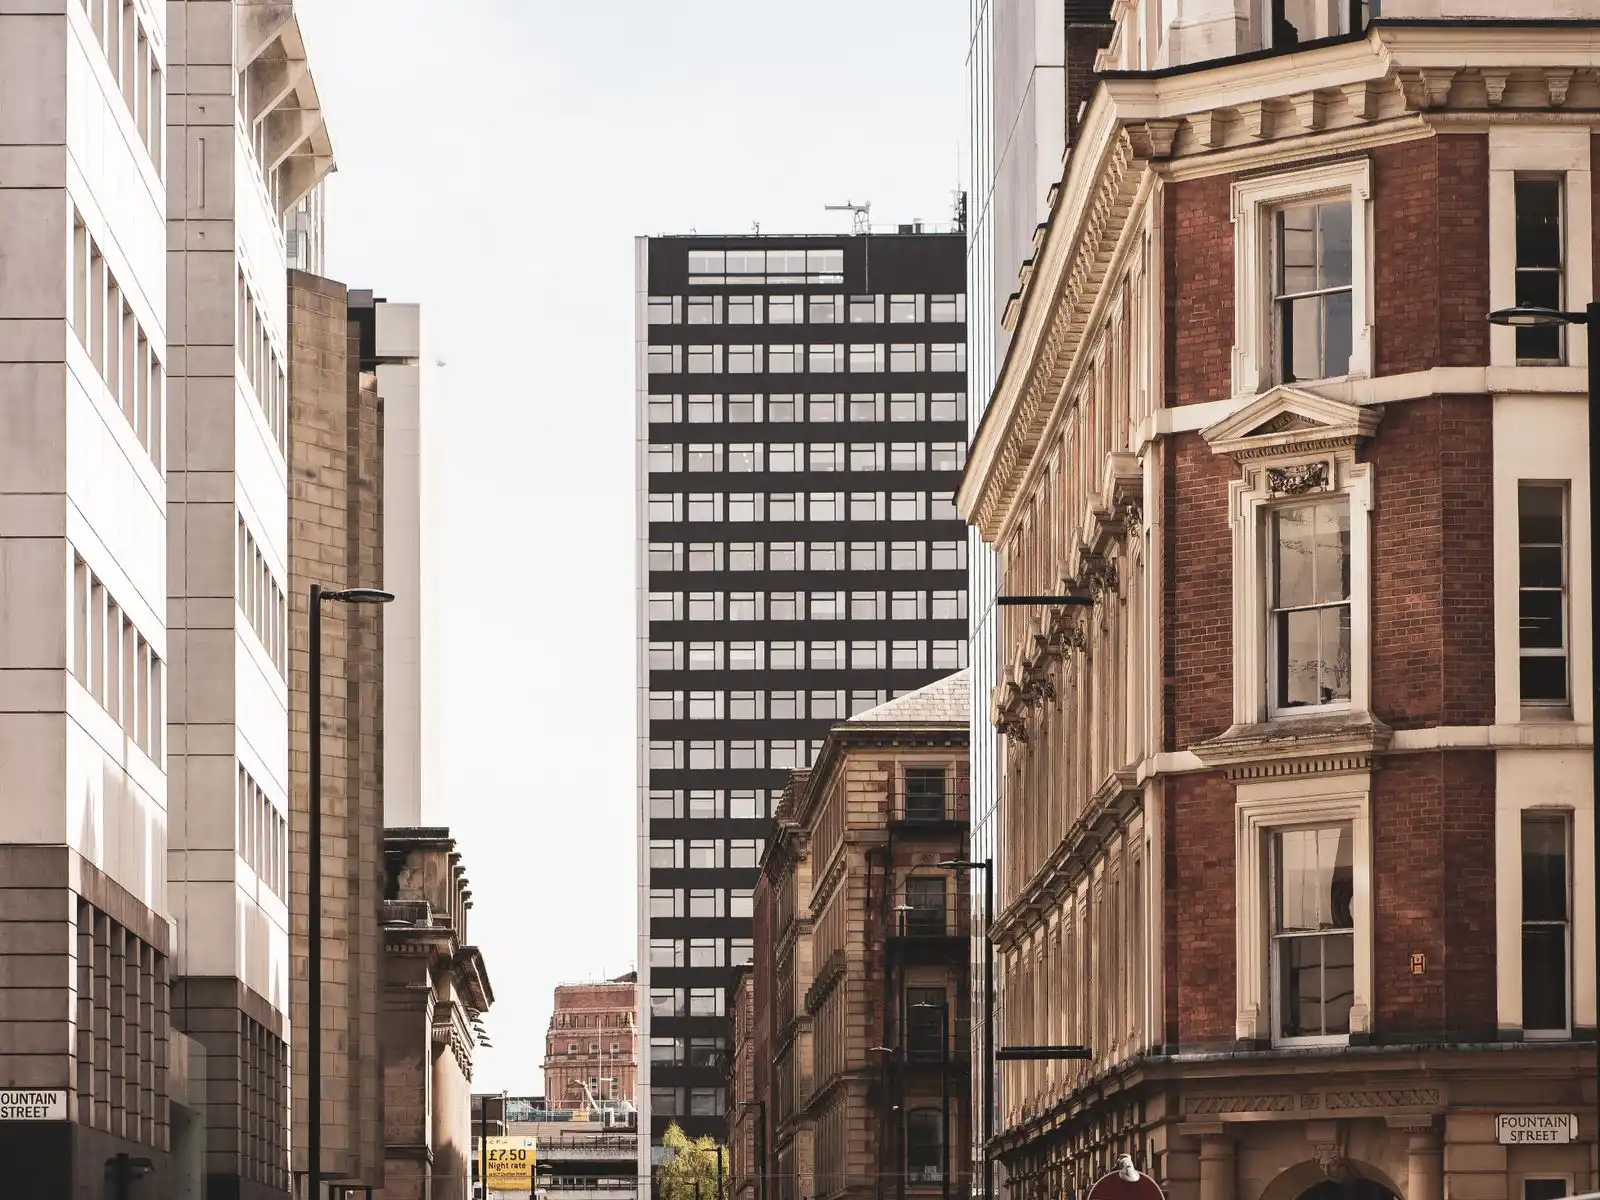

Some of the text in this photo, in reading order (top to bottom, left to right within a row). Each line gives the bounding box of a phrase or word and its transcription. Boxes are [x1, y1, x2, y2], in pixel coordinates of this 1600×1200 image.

[1, 1092, 57, 1105] OUNTAIN
[1, 1106, 49, 1118] STREET
[1501, 1116, 1567, 1128] FOUNTAIN
[1510, 1130, 1558, 1141] STREET
[488, 1148, 526, 1161] £7.50
[488, 1161, 509, 1171] Night
